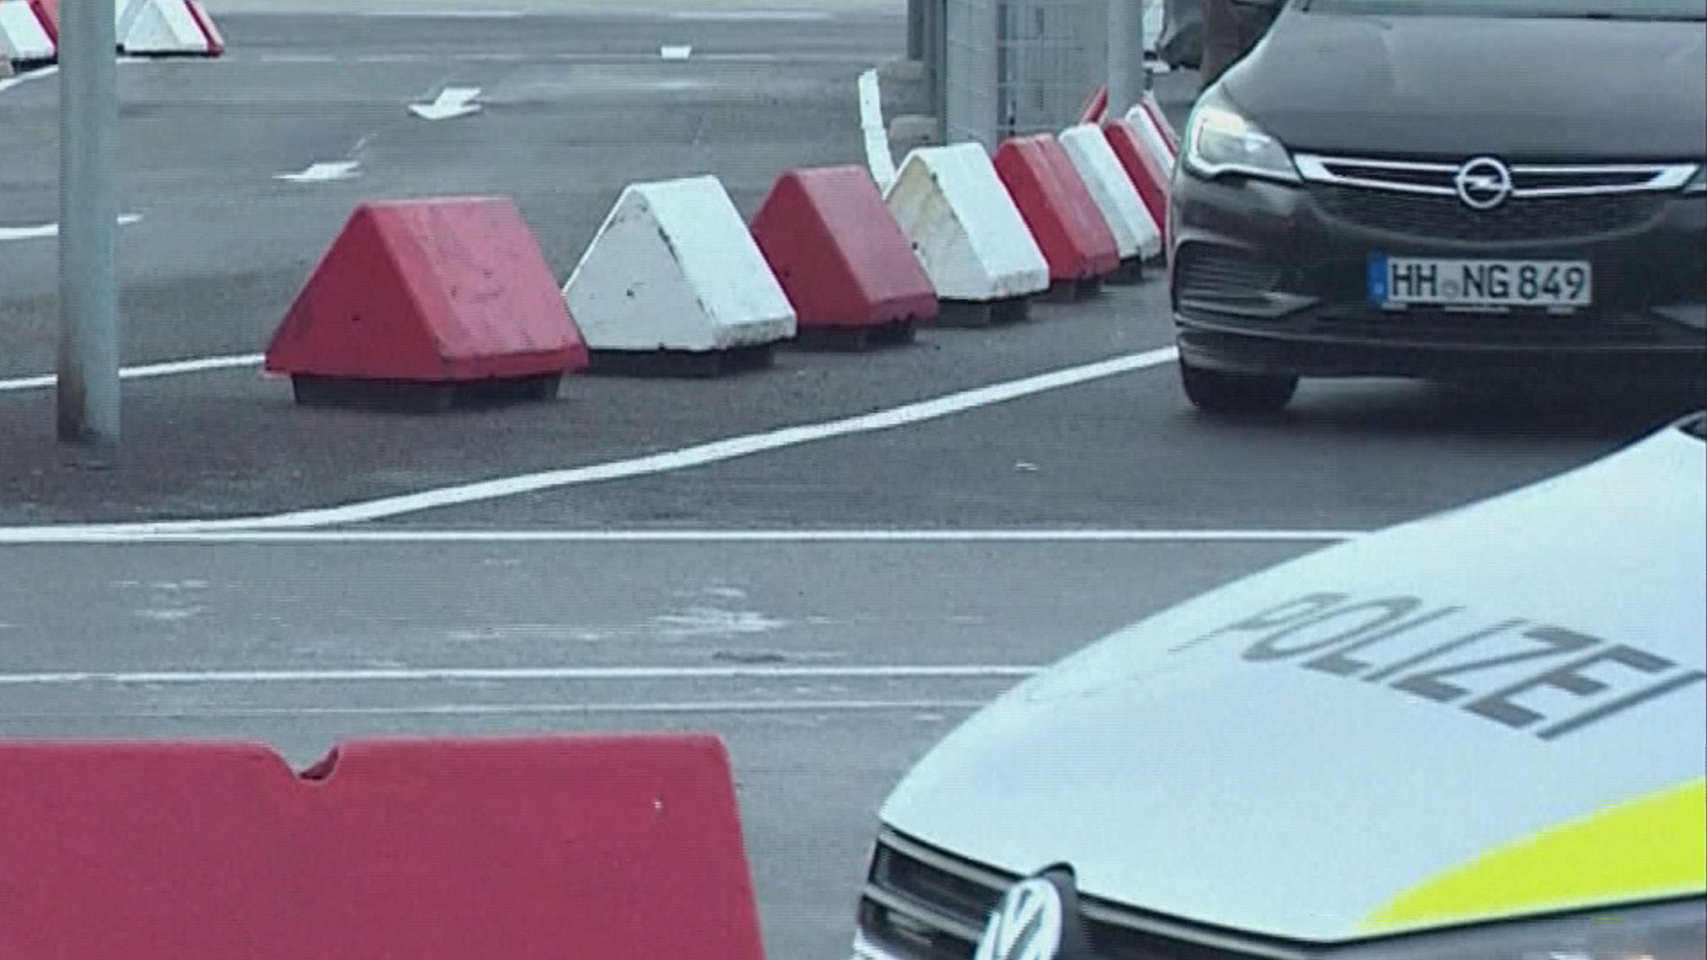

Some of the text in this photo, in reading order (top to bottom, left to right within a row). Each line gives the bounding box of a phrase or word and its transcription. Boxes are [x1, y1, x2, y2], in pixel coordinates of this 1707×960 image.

[1391, 263, 1585, 300] HH NG 849
[1168, 591, 1707, 741] POLIZEI
